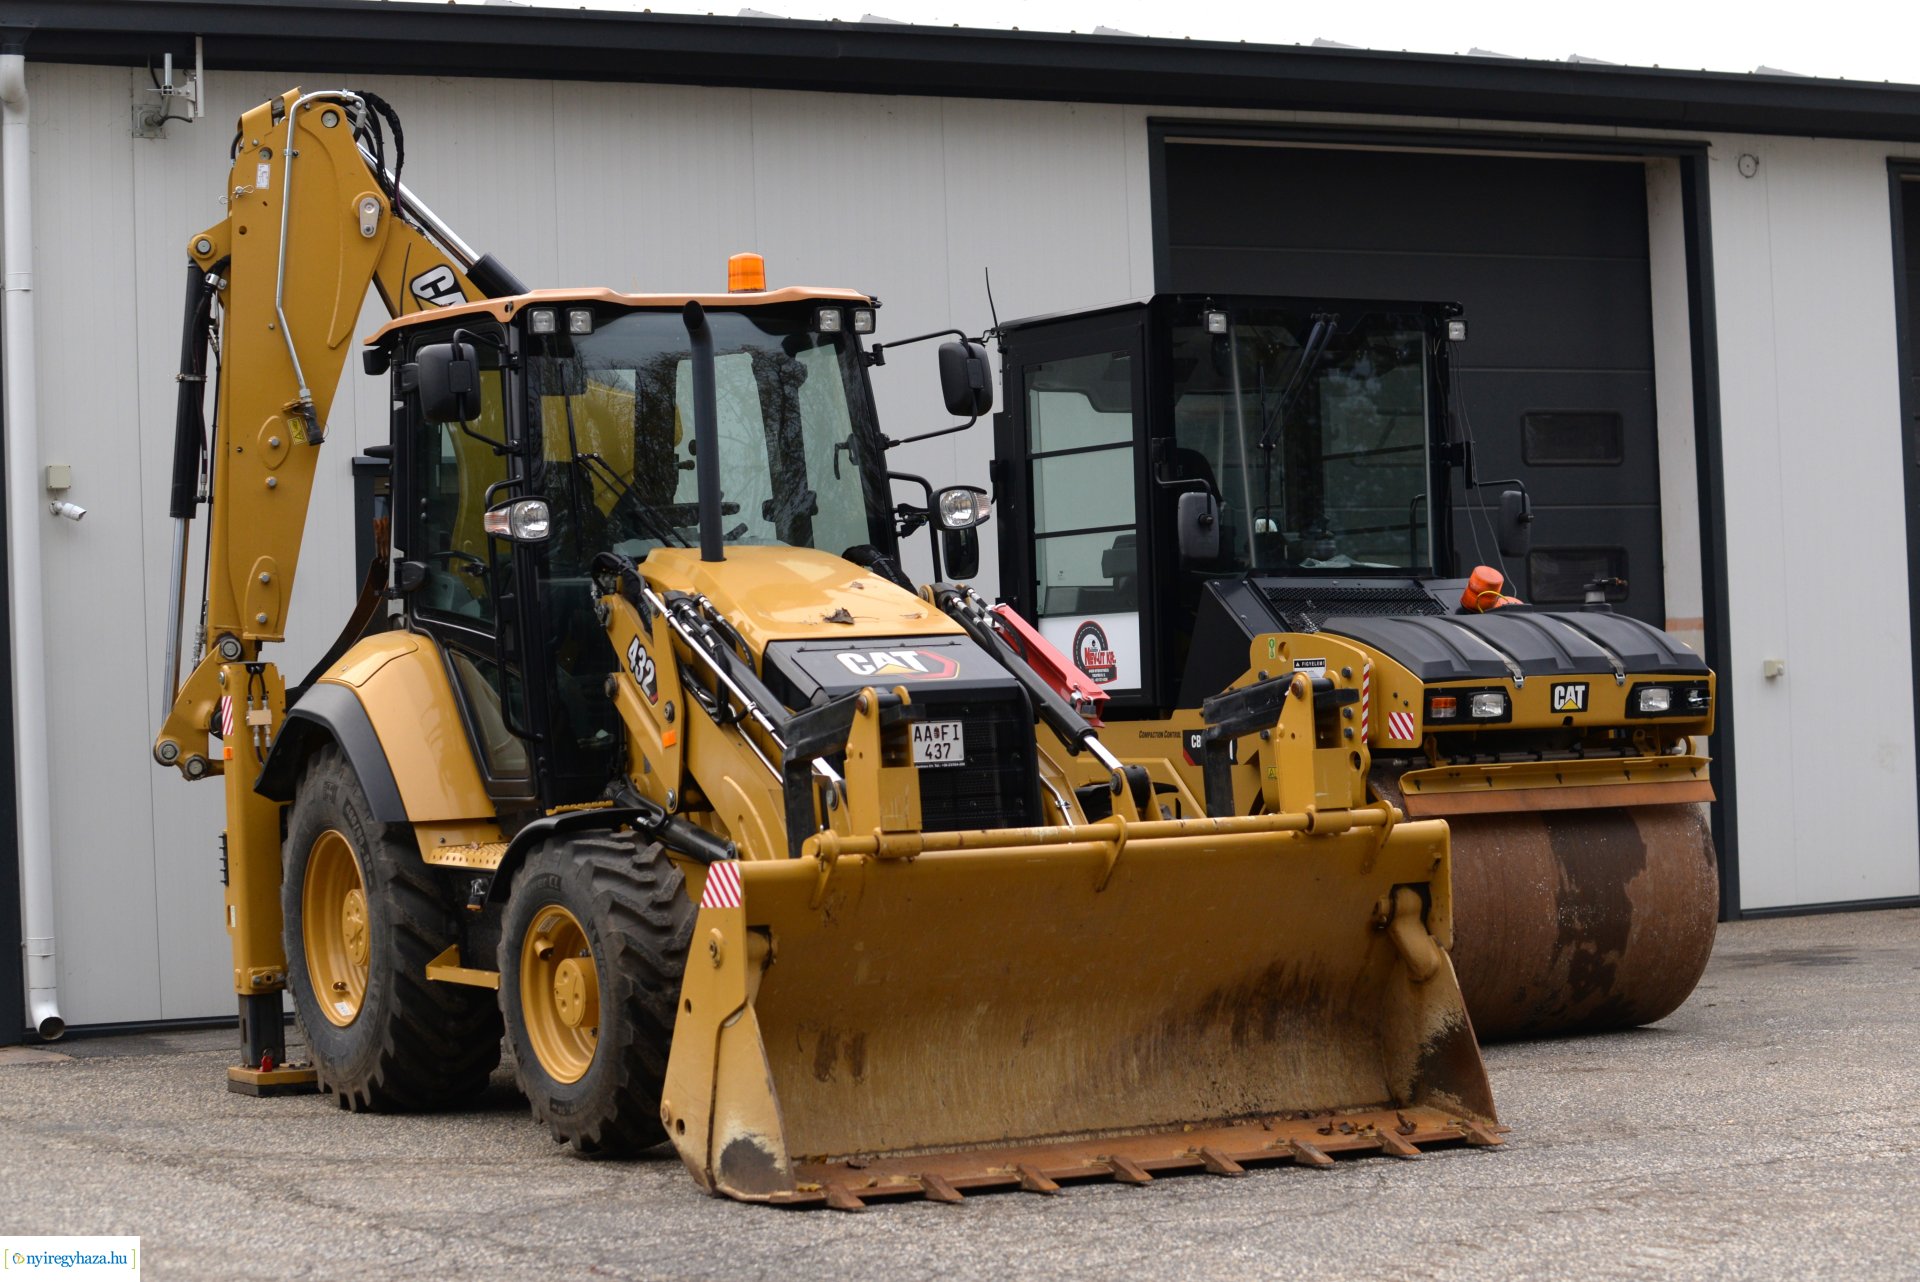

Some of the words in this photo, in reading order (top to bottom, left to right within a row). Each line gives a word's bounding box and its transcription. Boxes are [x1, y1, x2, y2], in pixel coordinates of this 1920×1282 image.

[628, 636, 655, 698] 432
[836, 650, 930, 676] CAT
[1554, 685, 1586, 710] CAT
[914, 725, 933, 742] AA
[941, 724, 960, 741] FI
[925, 743, 951, 760] 437
